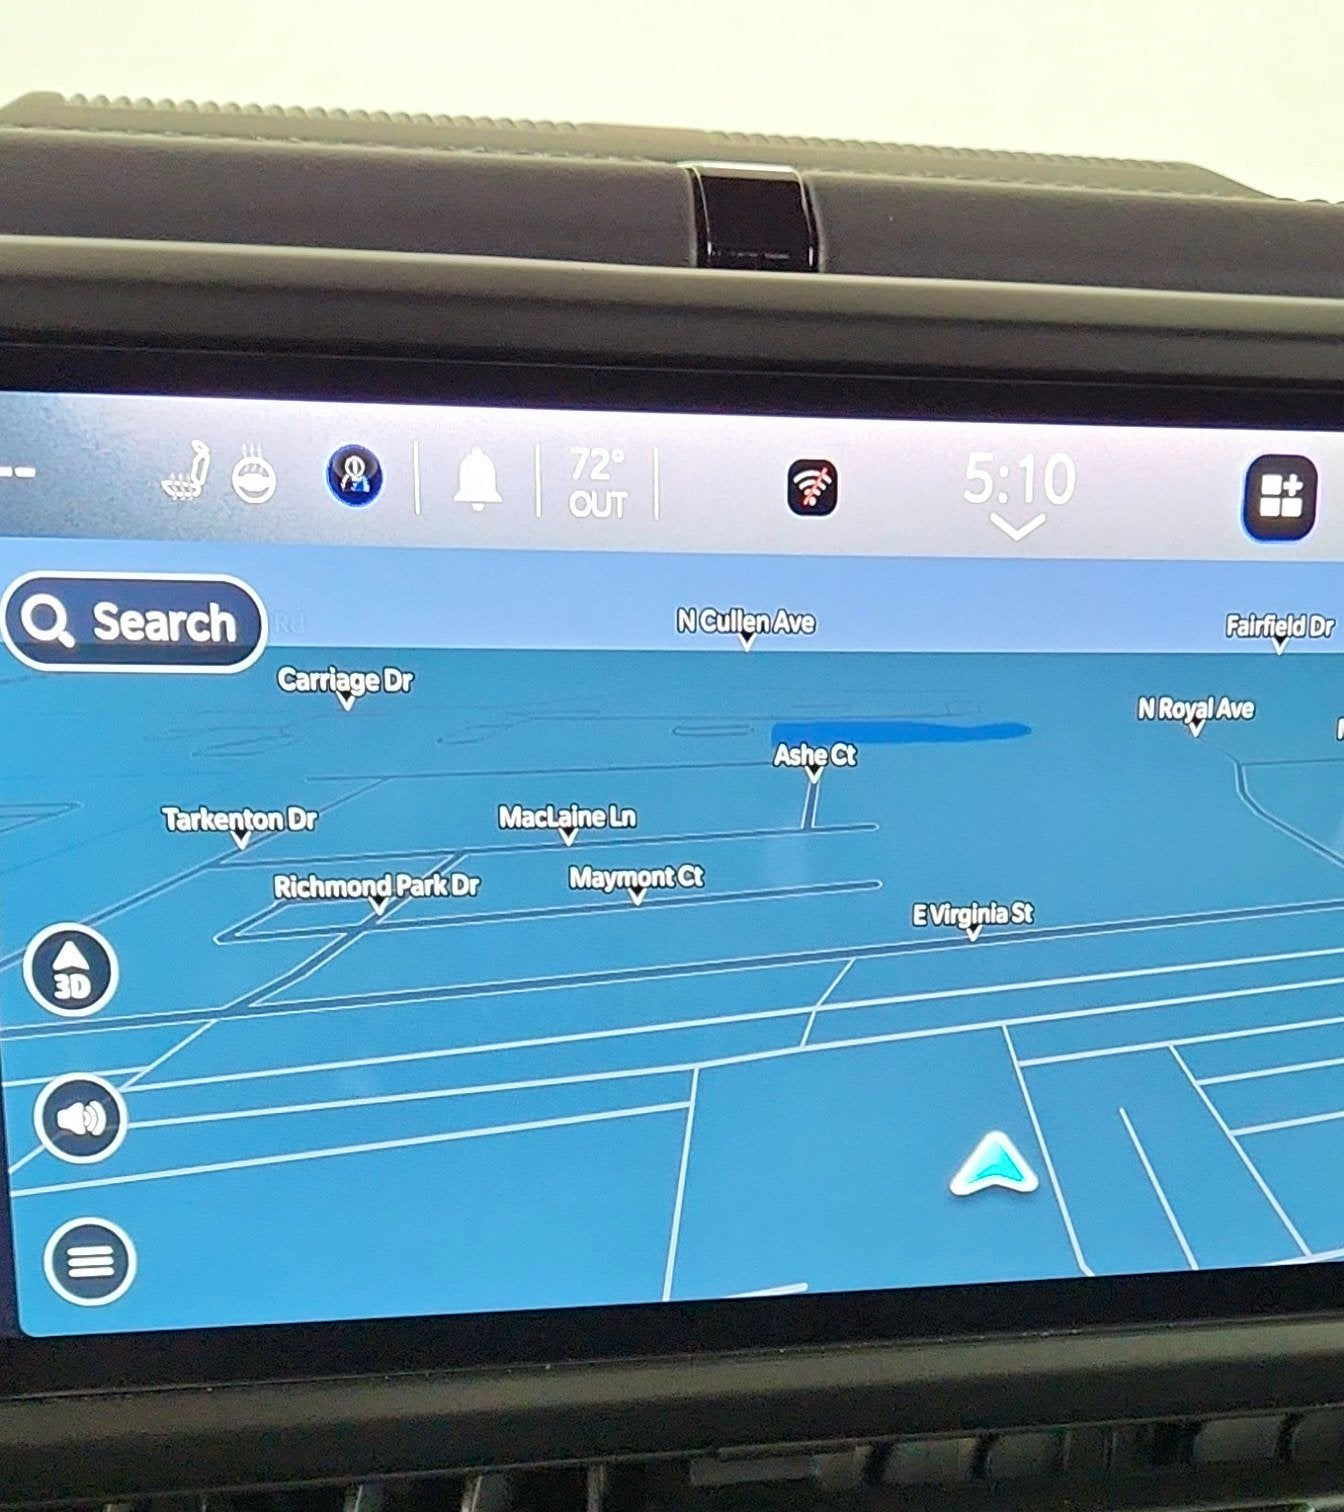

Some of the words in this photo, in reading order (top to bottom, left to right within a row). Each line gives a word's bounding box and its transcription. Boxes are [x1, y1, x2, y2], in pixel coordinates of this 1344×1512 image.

[963, 452, 1077, 506] 5:10
[568, 490, 629, 520] OUT
[93, 603, 237, 645] Search
[676, 607, 696, 632] N
[698, 607, 770, 634] Cullen
[771, 611, 817, 635] Ave
[1226, 614, 1306, 639] Fairfield
[1308, 616, 1337, 639] Dr
[277, 664, 381, 698] Carriage
[382, 667, 415, 693] Dr
[1138, 697, 1157, 720] N
[1158, 697, 1215, 724] Royal
[1216, 698, 1256, 722] Ave
[773, 743, 828, 768] Ashe
[829, 743, 858, 768] Ct
[162, 806, 286, 833] Tarkenton
[287, 807, 318, 832] Dr
[498, 804, 606, 829] MacLaine
[607, 806, 638, 829] Ln
[273, 874, 393, 900] Richmond
[394, 873, 451, 898] Park
[451, 874, 481, 897] Dr
[568, 865, 674, 892] Maymont
[675, 864, 705, 889] Ct
[912, 904, 928, 926] E
[928, 904, 1009, 931] Virginia
[1010, 901, 1034, 925] St
[52, 973, 93, 1001] 3D
